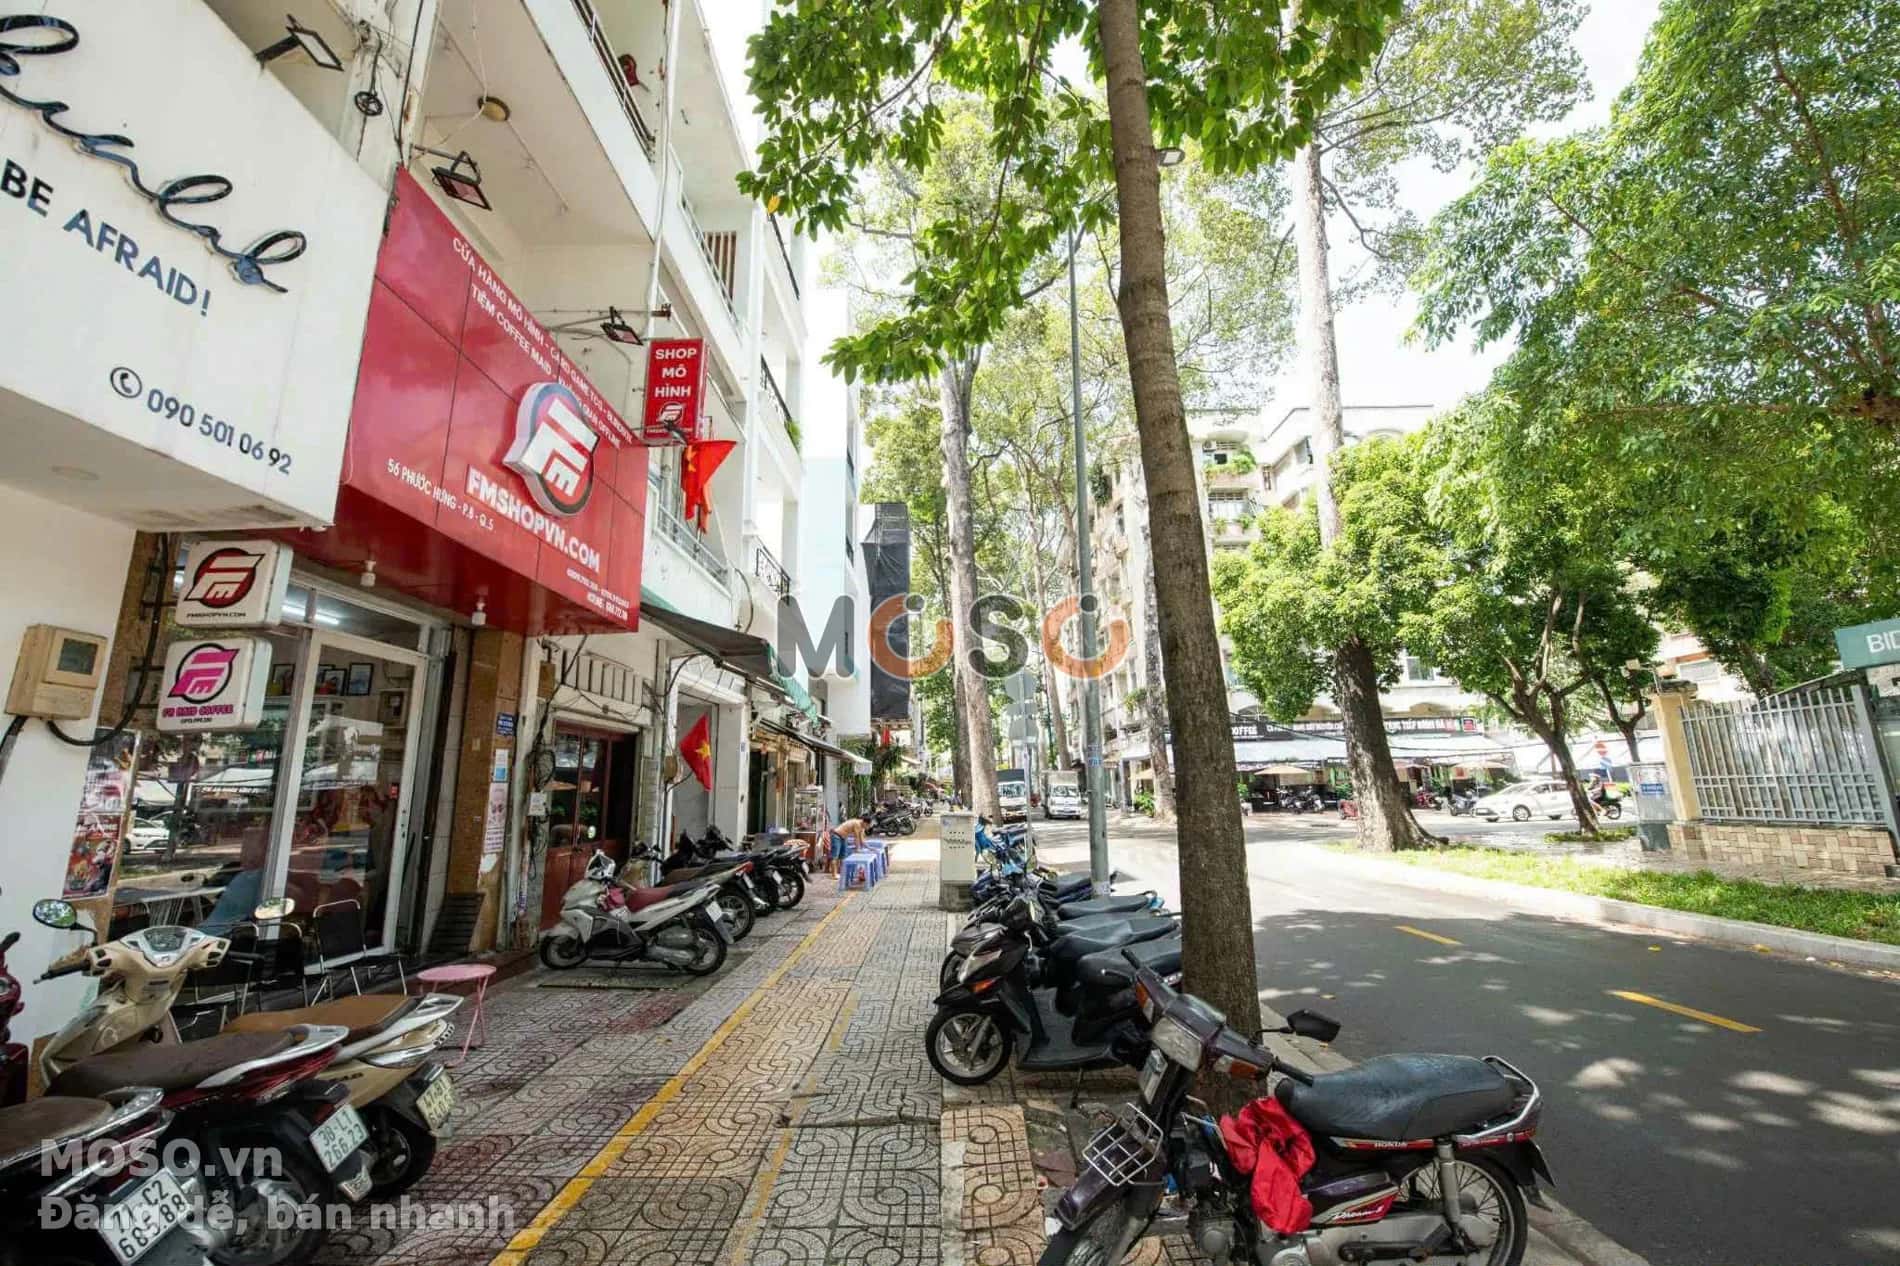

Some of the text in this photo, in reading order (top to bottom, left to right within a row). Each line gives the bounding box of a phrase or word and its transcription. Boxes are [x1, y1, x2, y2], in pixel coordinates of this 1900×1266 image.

[1, 158, 53, 217] BE
[62, 209, 211, 317] AFRAID!
[497, 311, 530, 354] COFFEE
[655, 348, 697, 360] SHOP
[662, 364, 687, 378] MÔ
[654, 383, 692, 398] HÌNH
[147, 388, 194, 427] 090
[199, 414, 234, 446] 501
[387, 458, 400, 477] 56
[467, 466, 600, 575] FMSHOPVN.COM
[1231, 724, 1257, 736] OFFEE
[324, 1124, 364, 1167] 266.23
